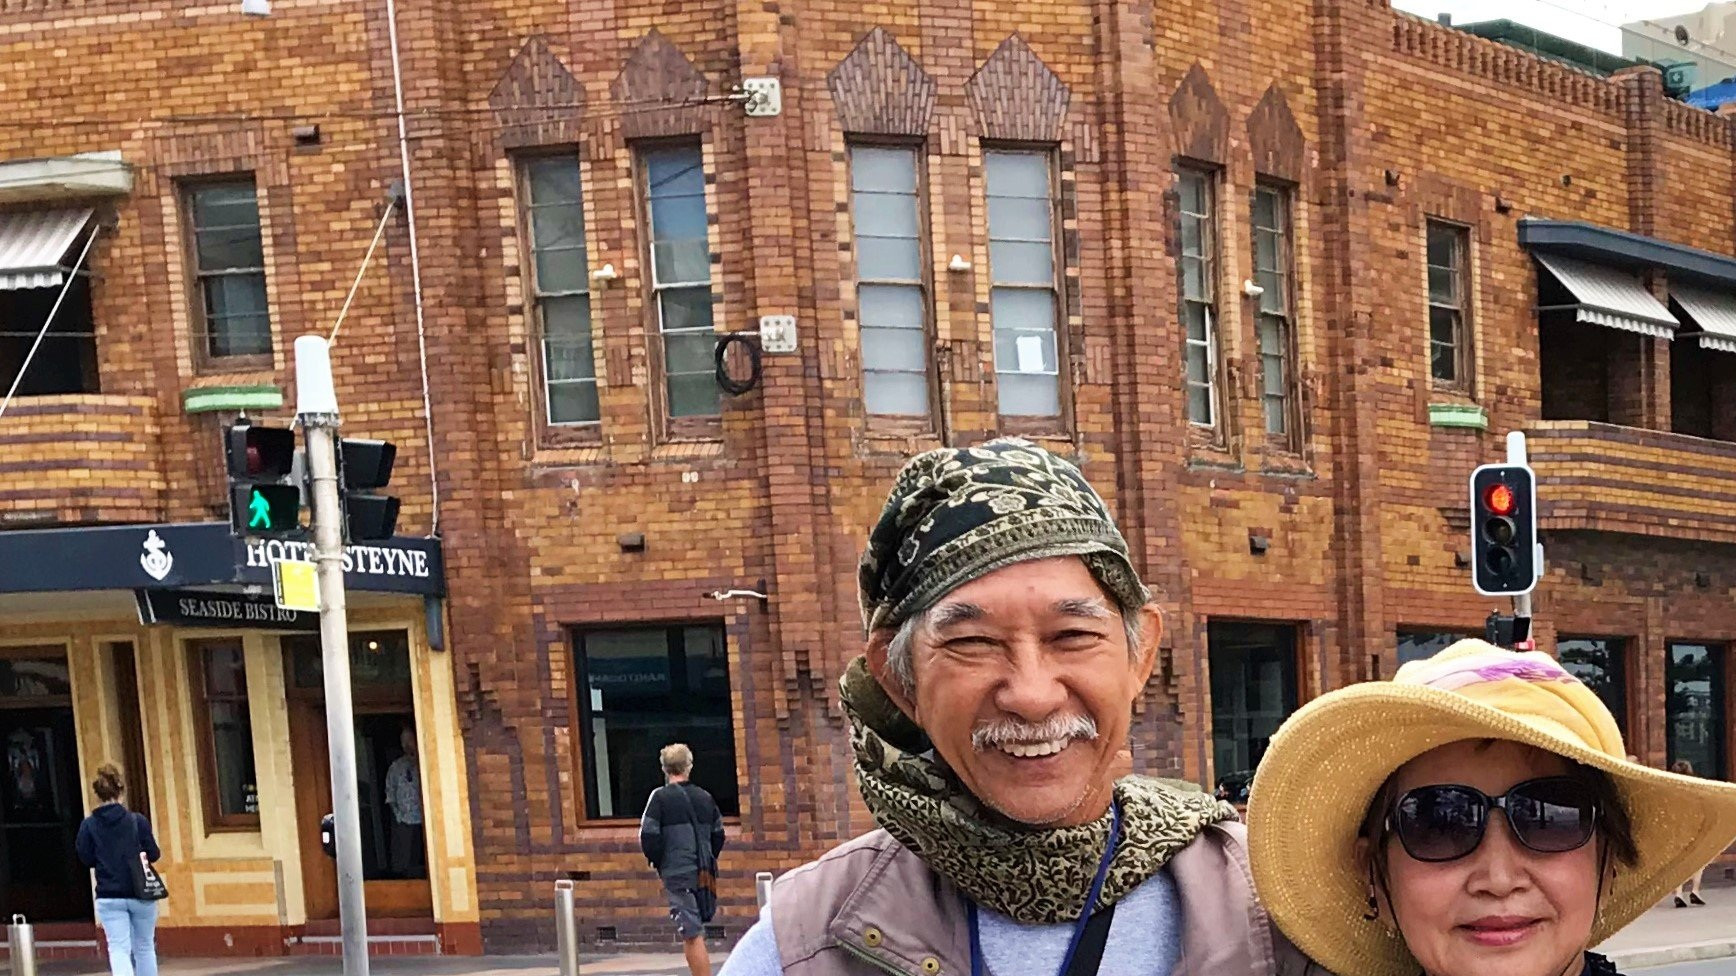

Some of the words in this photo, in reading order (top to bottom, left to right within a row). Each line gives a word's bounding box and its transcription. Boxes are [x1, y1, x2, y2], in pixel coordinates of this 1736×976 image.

[342, 545, 429, 577] STEYNE
[179, 599, 242, 619] SEASIDE
[245, 603, 297, 622] BISTRO
